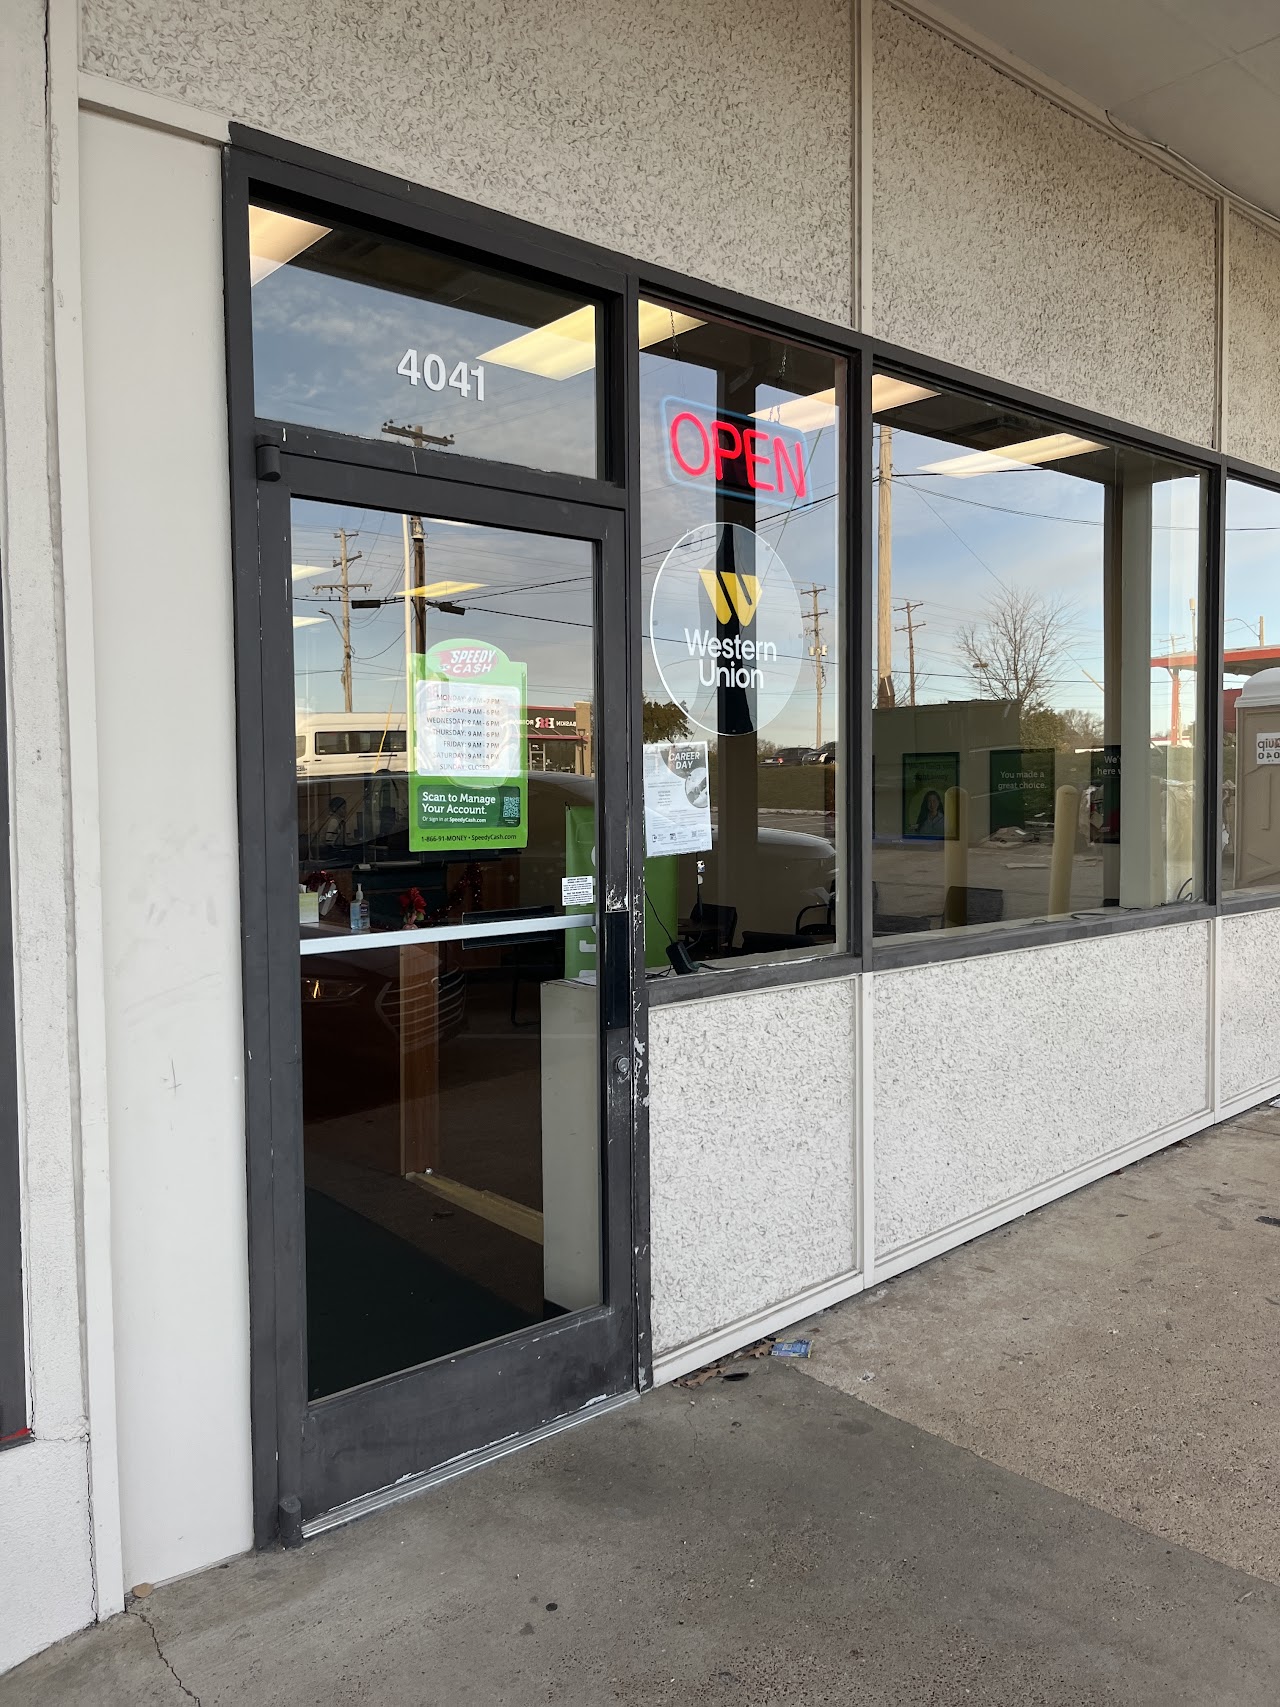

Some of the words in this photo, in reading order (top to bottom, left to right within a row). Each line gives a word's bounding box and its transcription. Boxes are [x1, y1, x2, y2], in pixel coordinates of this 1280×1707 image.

[397, 349, 485, 402] 4041
[669, 411, 807, 498] OPEN
[683, 627, 777, 662] Western
[450, 650, 497, 664] SPEEDY
[699, 658, 765, 689] Union
[668, 751, 700, 761] CAREER
[675, 761, 693, 770] DAY
[1000, 771, 1015, 779] You
[1019, 781, 1047, 789] choice.
[422, 792, 447, 802] Scan
[448, 793, 458, 802] to
[459, 793, 496, 806] Manage
[421, 803, 445, 814] Your
[446, 804, 488, 815] Account.
[471, 834, 517, 842] SpeedyCash.com
